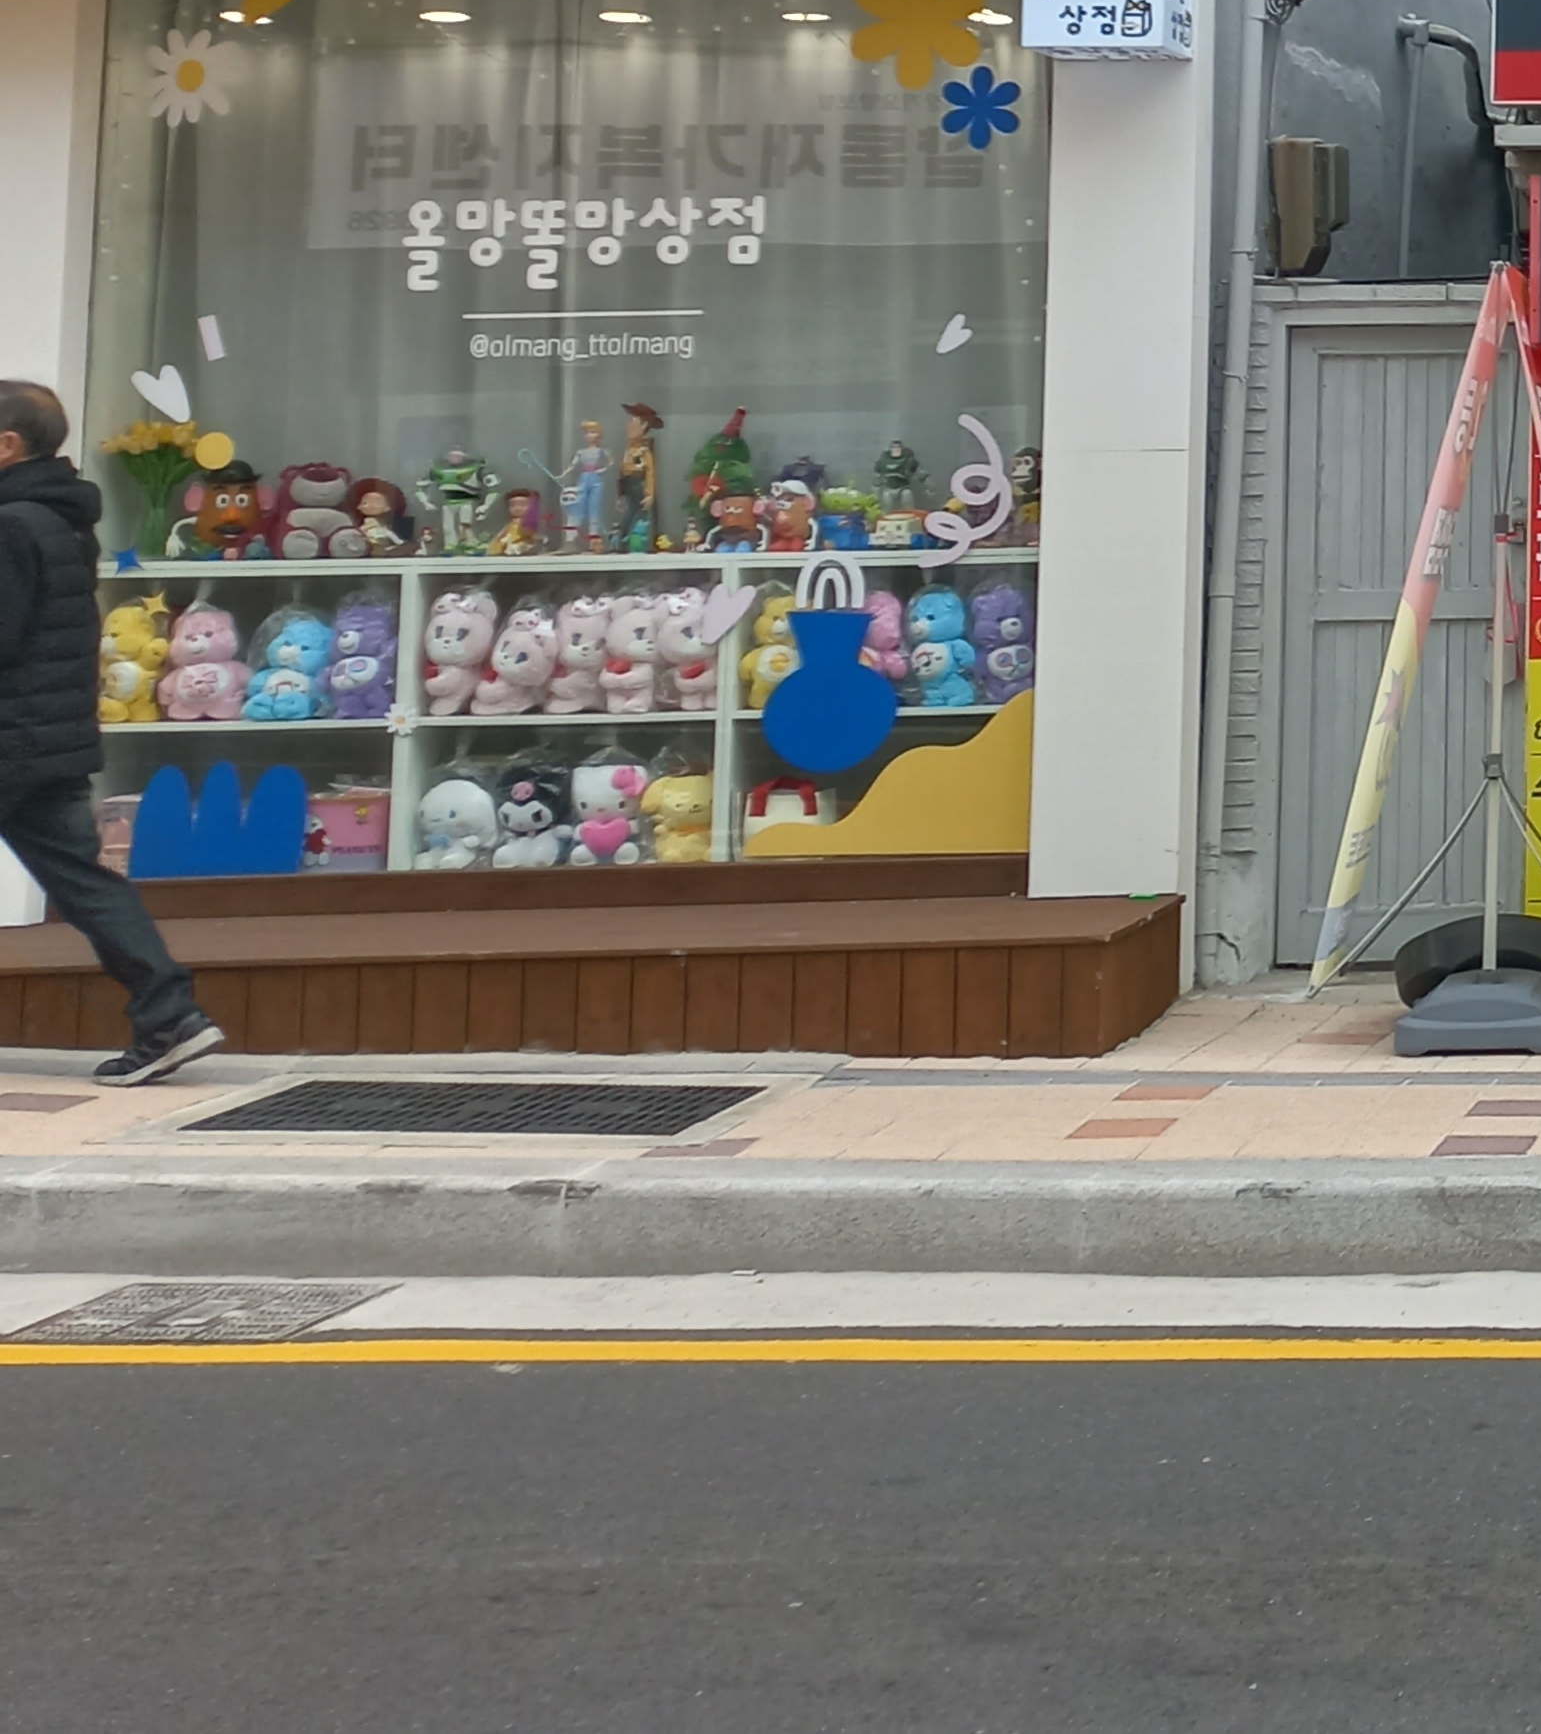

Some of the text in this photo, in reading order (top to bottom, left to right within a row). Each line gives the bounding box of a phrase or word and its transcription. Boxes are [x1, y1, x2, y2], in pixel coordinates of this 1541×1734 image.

[1058, 4, 1118, 36] 상점
[401, 196, 766, 292] 올망똘망상점
[468, 331, 694, 362] @olmang_ttolmang
